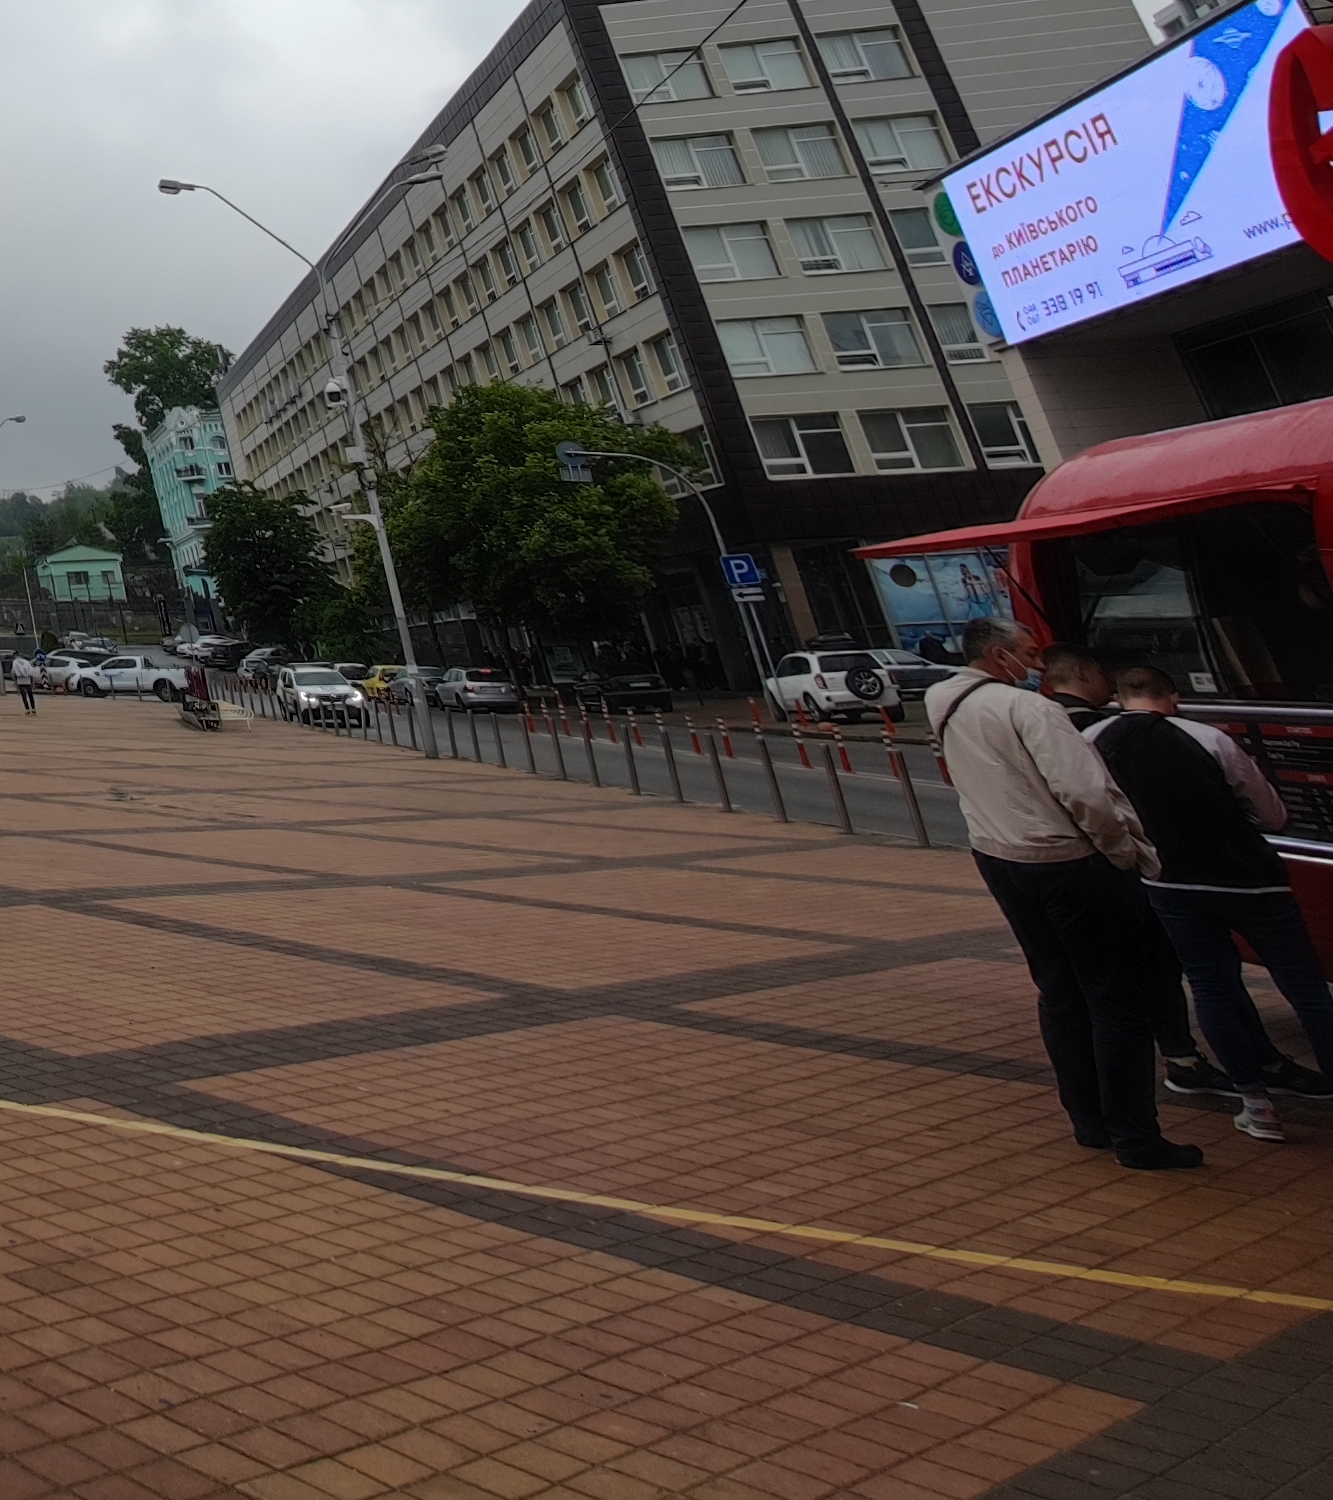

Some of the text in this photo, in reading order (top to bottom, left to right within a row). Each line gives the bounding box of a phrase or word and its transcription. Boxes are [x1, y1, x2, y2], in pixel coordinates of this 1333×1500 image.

[965, 112, 1118, 214] ЕКСКУРСІЯ
[1004, 196, 1098, 251] КИЇВСЬКОГО
[1001, 235, 1098, 288] ПЛАНЕТАРІЮ
[1041, 281, 1104, 316] 338 19 91
[728, 559, 749, 583] P
